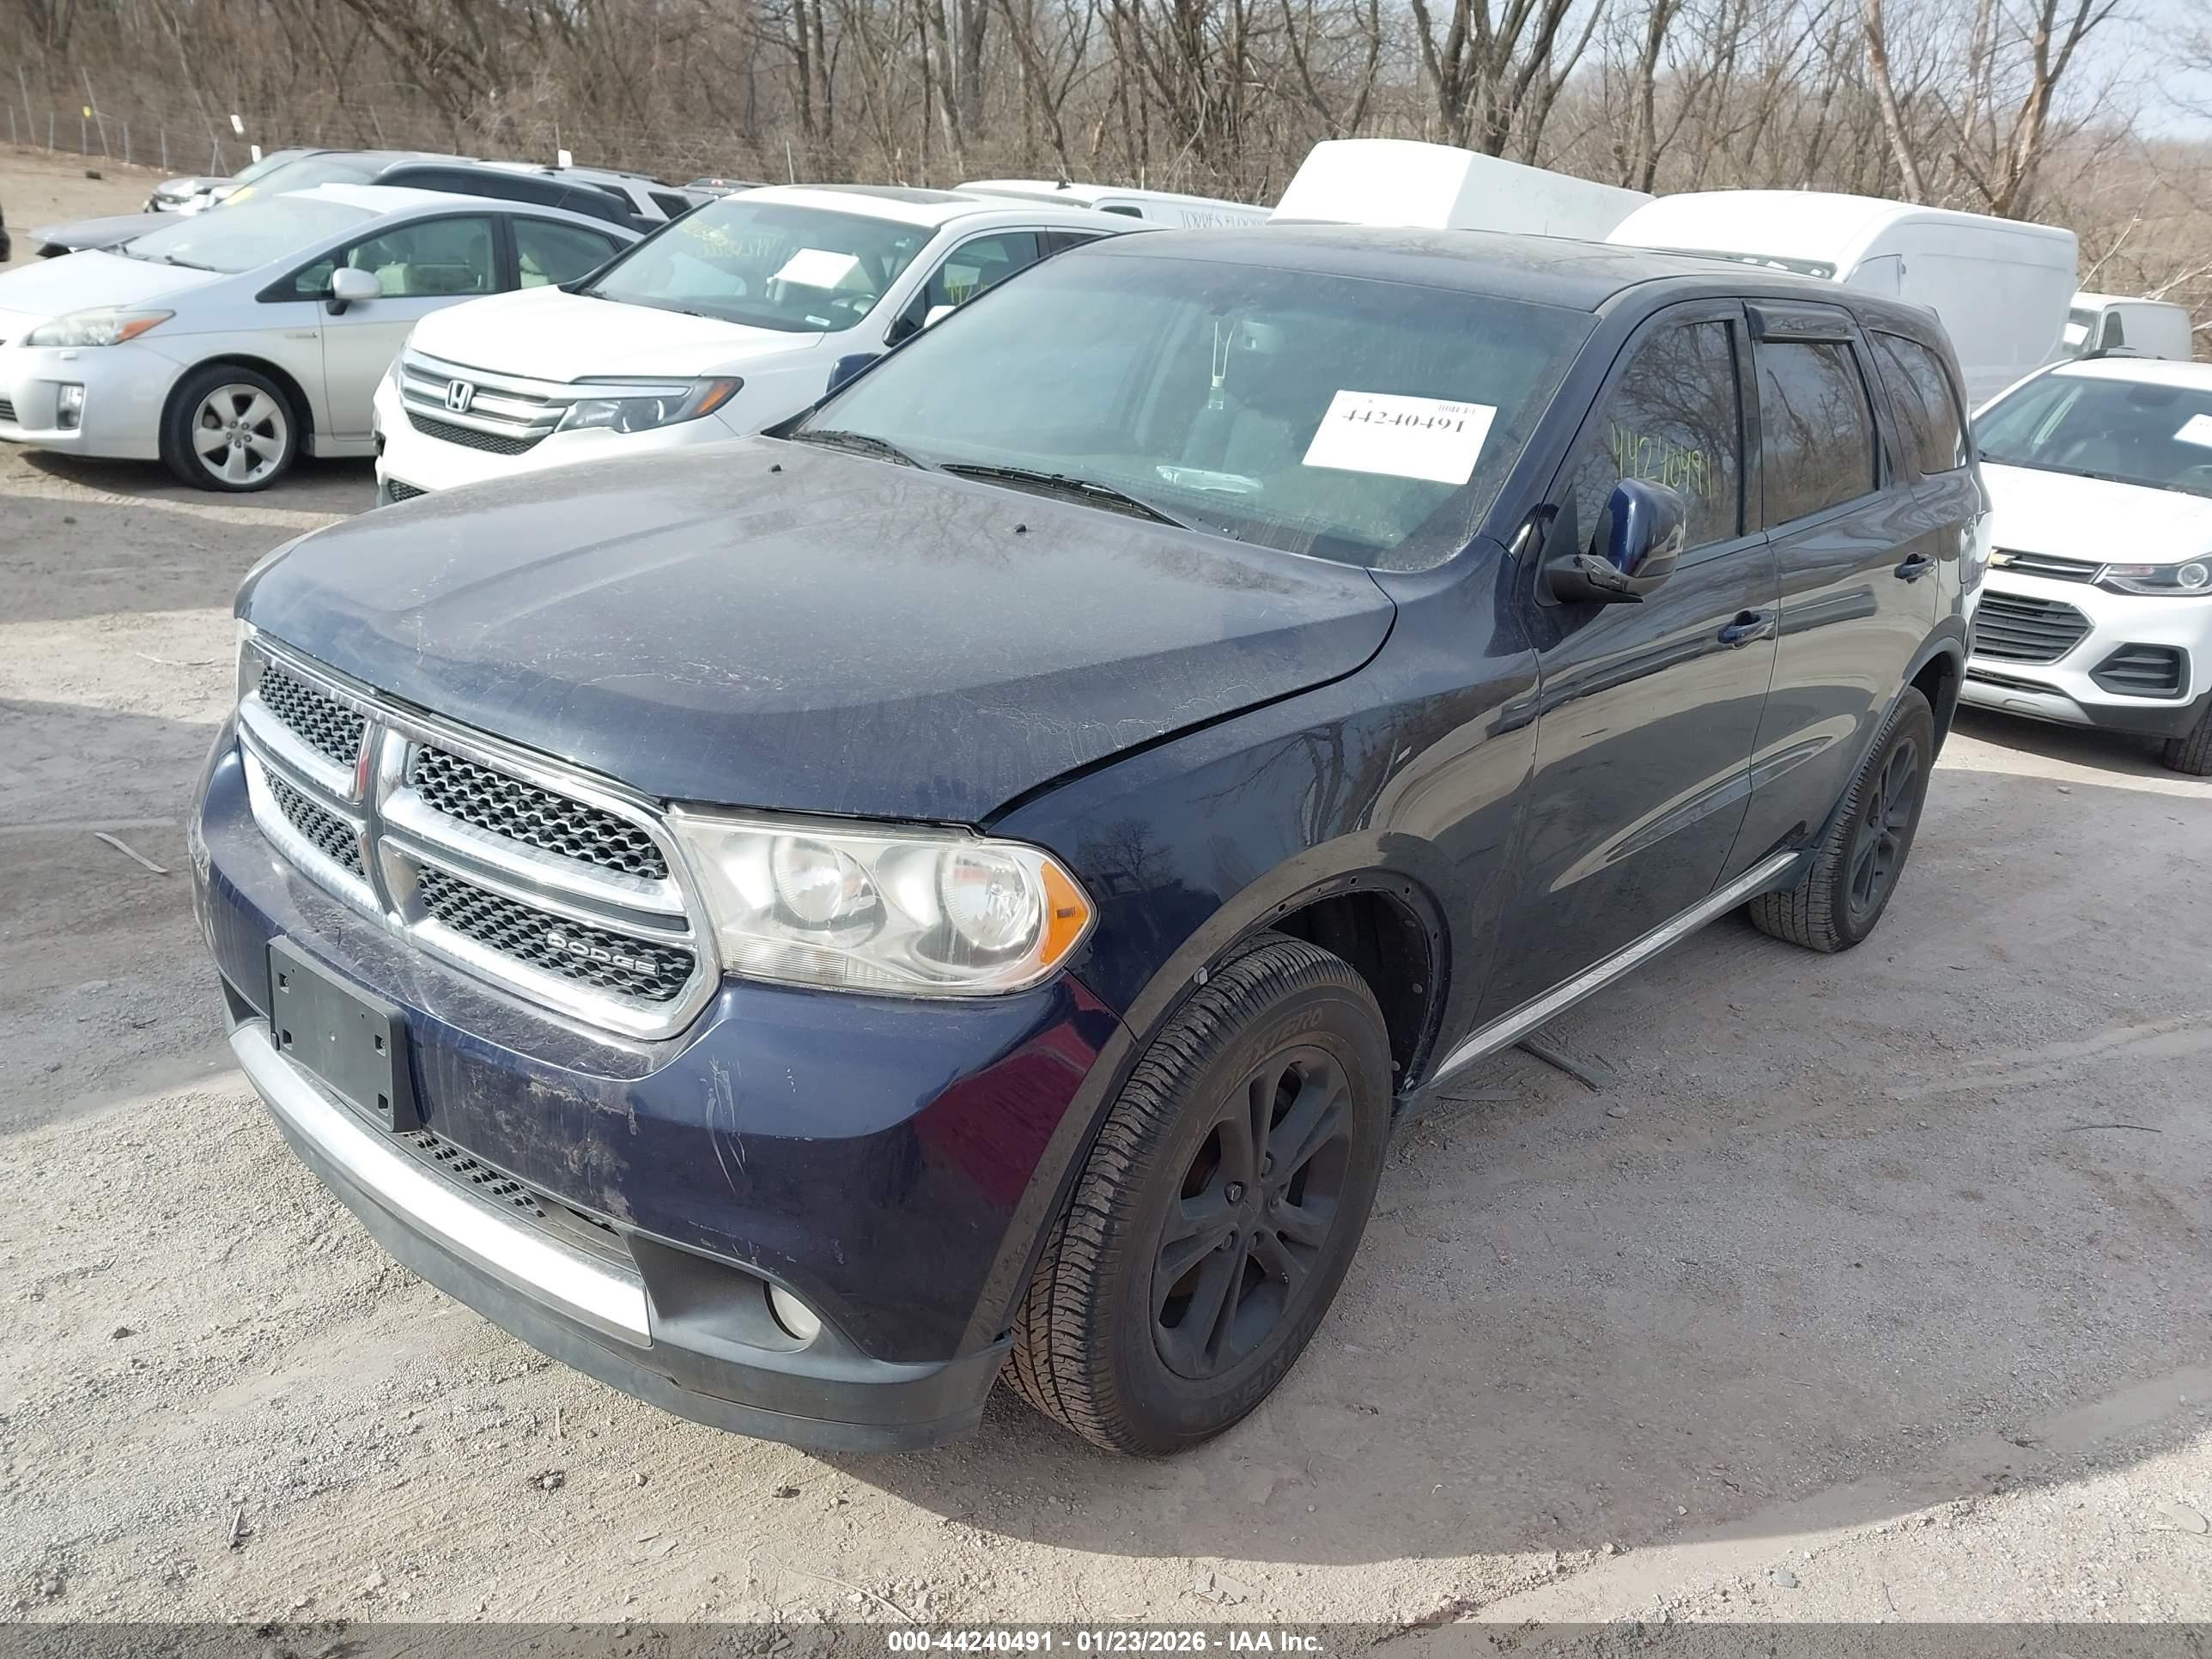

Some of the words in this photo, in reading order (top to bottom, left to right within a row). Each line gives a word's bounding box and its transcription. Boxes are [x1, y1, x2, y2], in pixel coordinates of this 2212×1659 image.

[1342, 409, 1466, 433] 44240491
[1612, 422, 1711, 499] 44240491
[547, 932, 657, 976] DODGE
